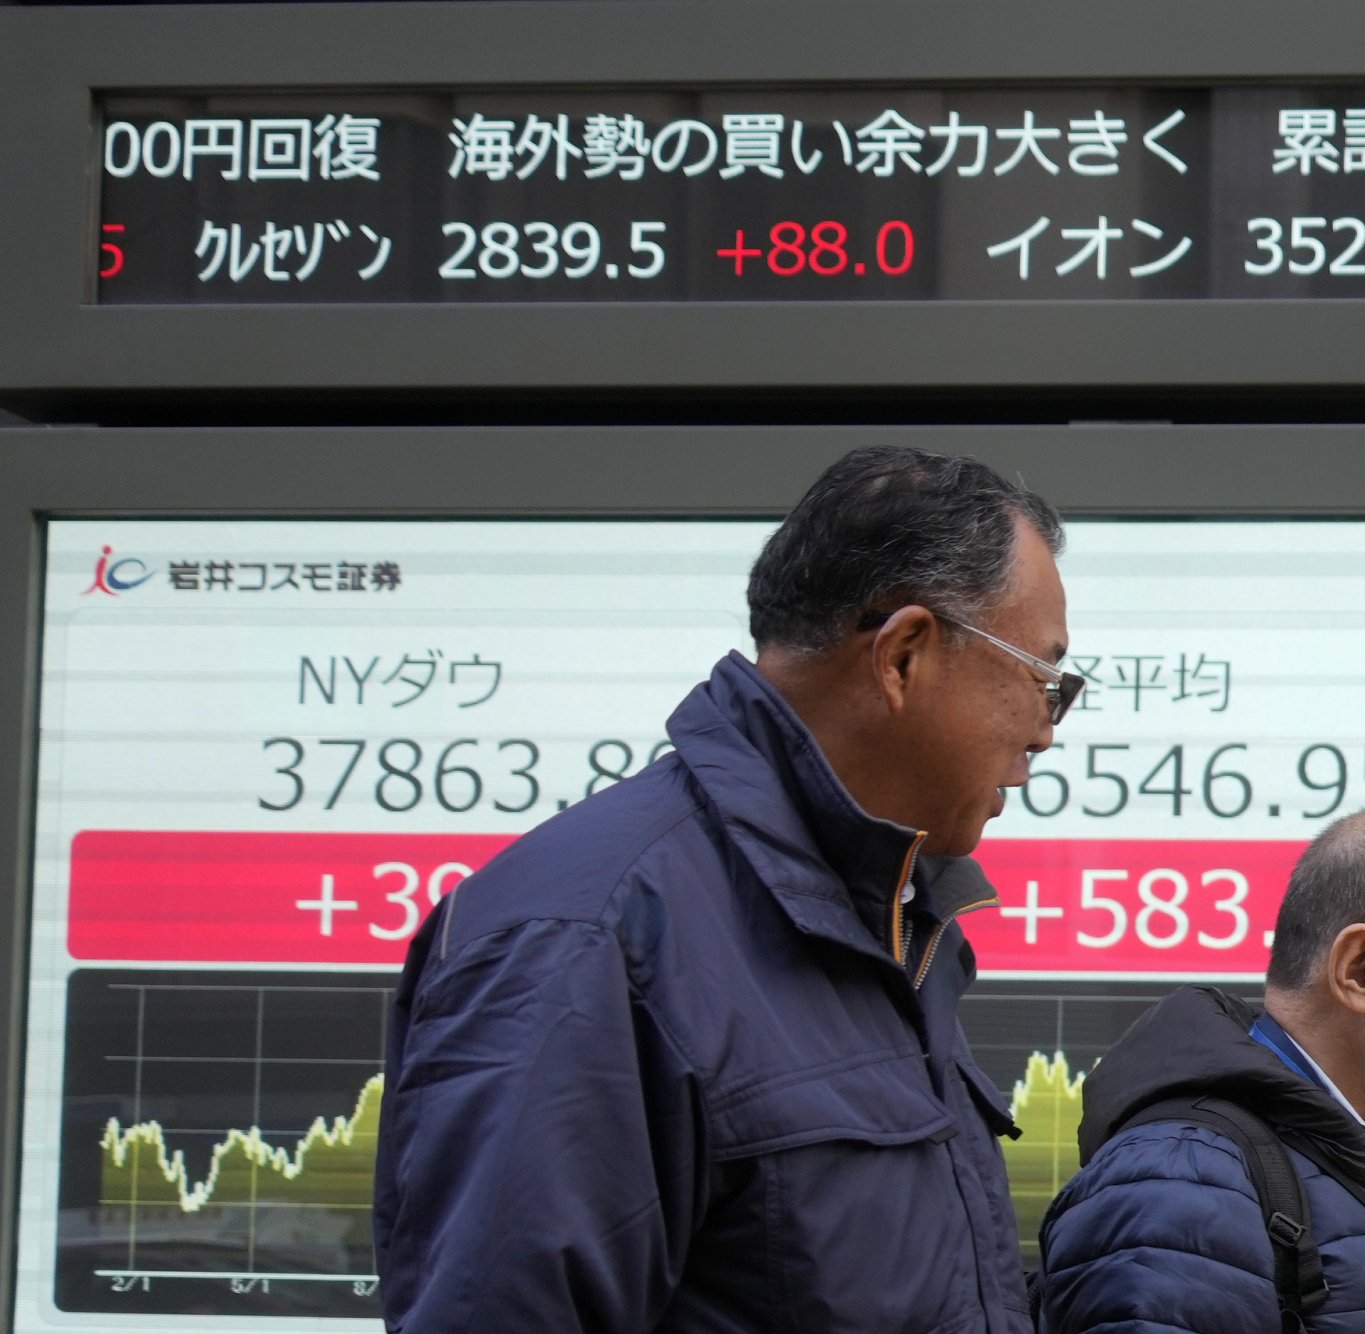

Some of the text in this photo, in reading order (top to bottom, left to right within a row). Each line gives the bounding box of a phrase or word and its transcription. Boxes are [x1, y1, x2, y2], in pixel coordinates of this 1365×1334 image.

[105, 113, 380, 182] 00円回復
[448, 109, 1187, 181] 海外勢の買い余力大きく
[438, 221, 666, 278] 2839.5
[716, 219, 916, 277] +88.0
[986, 215, 1192, 280] イオン
[168, 559, 402, 592] 岩井コスモ証券
[299, 649, 501, 708] NYダウ
[257, 737, 674, 813] 37863.8
[110, 1276, 151, 1293] 2/1
[230, 1277, 271, 1294] 5/1
